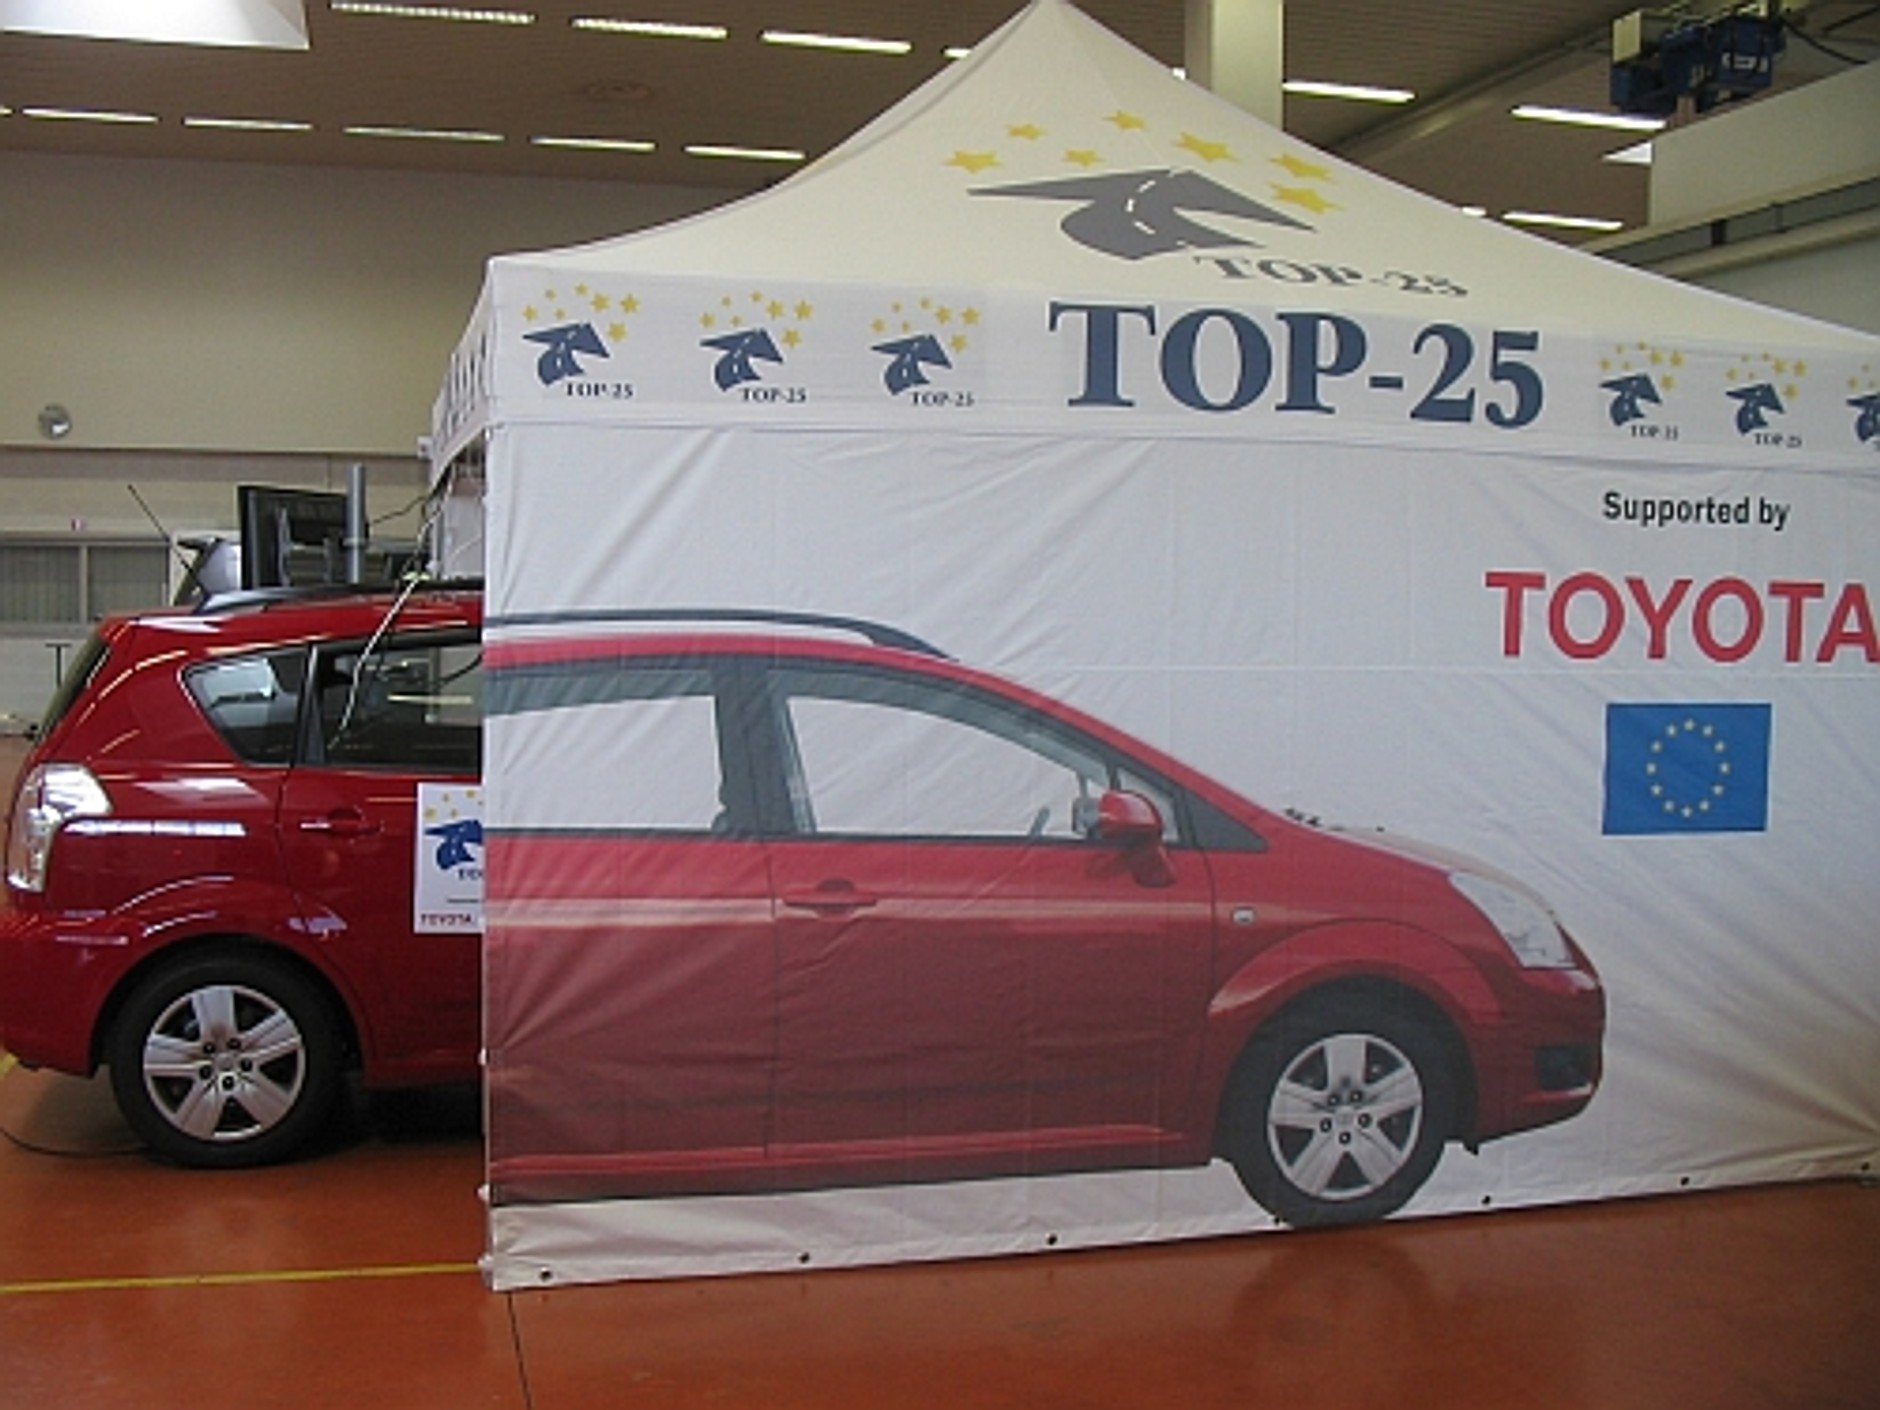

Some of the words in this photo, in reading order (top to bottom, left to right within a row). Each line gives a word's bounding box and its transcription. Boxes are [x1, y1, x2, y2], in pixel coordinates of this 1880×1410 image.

[1193, 255, 1467, 296] TOP-25
[1049, 301, 1544, 428] TOP-25
[566, 382, 633, 399] TOP-25
[741, 388, 806, 404] TOP-25
[911, 391, 975, 407] TOP-25
[1603, 491, 1750, 528] Supported
[1758, 497, 1792, 532] by
[1485, 571, 1880, 663] TOYOTA
